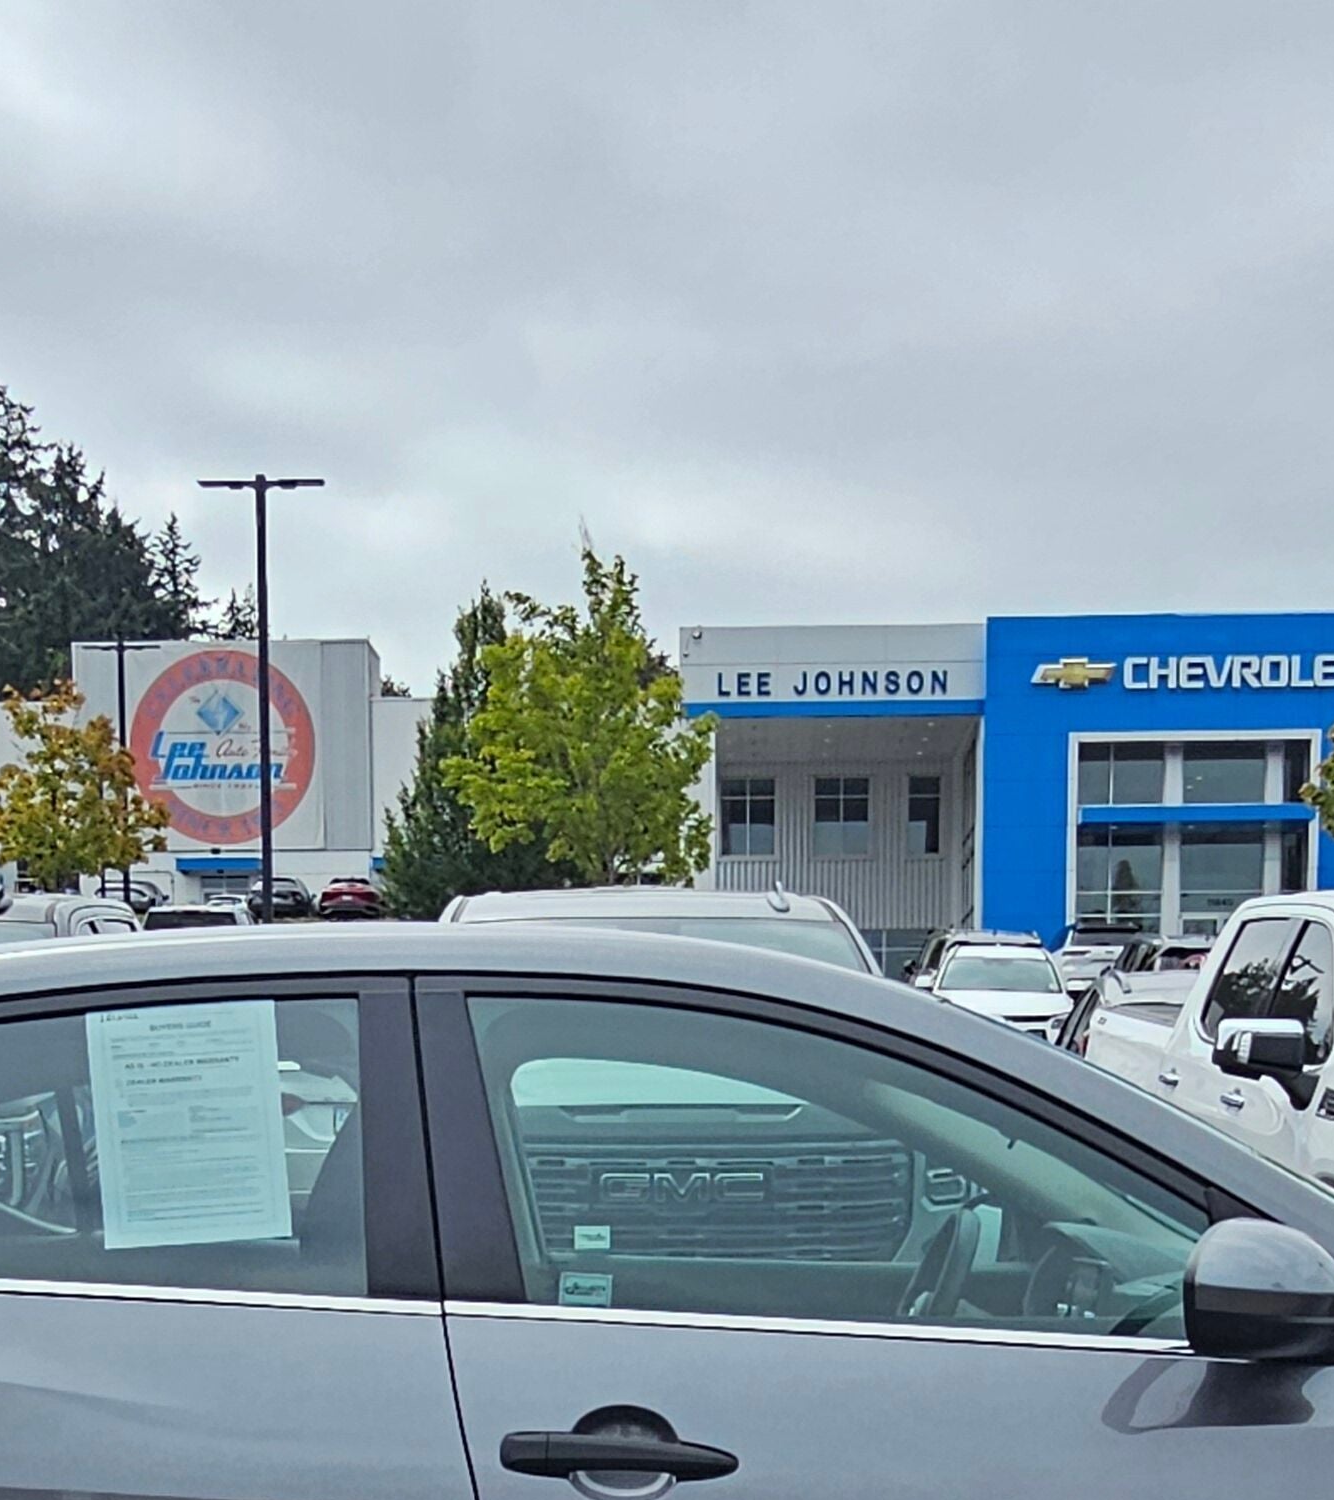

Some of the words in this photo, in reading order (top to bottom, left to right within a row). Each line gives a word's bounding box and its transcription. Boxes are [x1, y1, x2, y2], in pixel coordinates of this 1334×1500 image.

[717, 672, 772, 697] LEE
[793, 670, 948, 697] JOHNSON
[151, 731, 208, 758] Lee
[600, 1172, 764, 1203] GMC
